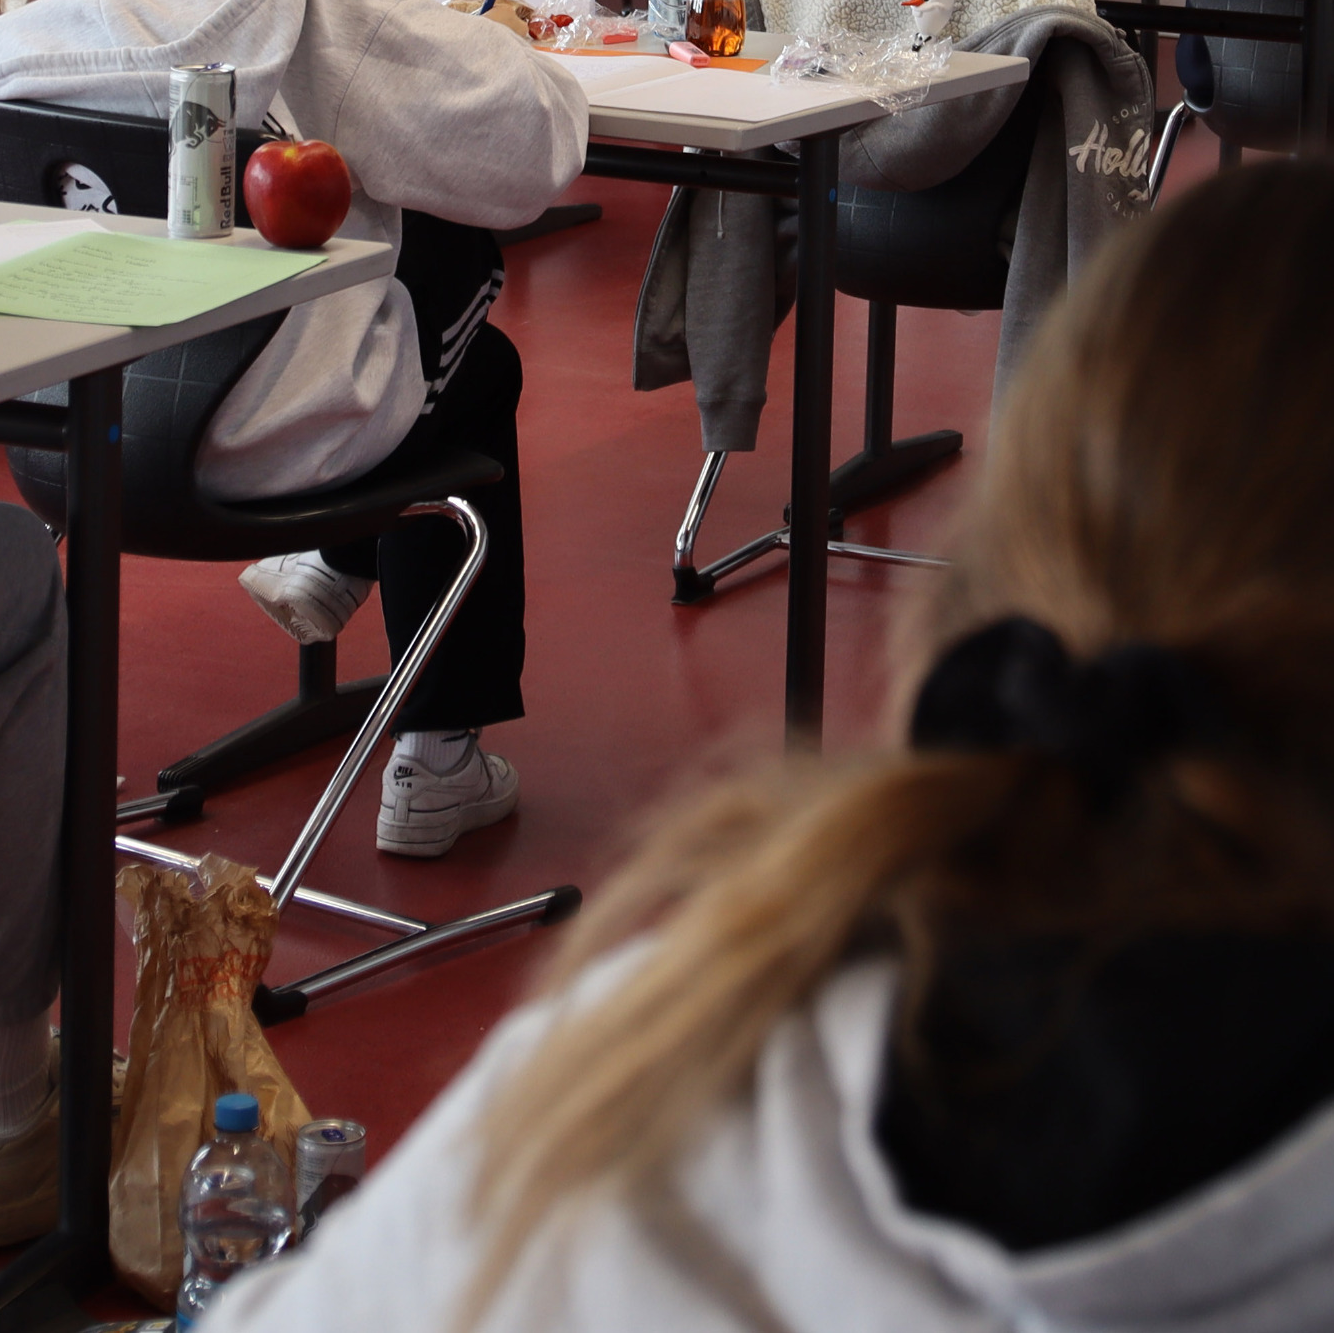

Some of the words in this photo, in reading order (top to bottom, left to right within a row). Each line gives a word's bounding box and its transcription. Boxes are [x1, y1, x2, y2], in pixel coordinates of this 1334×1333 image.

[220, 166, 232, 197] Bull
[220, 199, 232, 230] Red
[397, 765, 414, 774] NIKE
[395, 781, 413, 789] AIR
